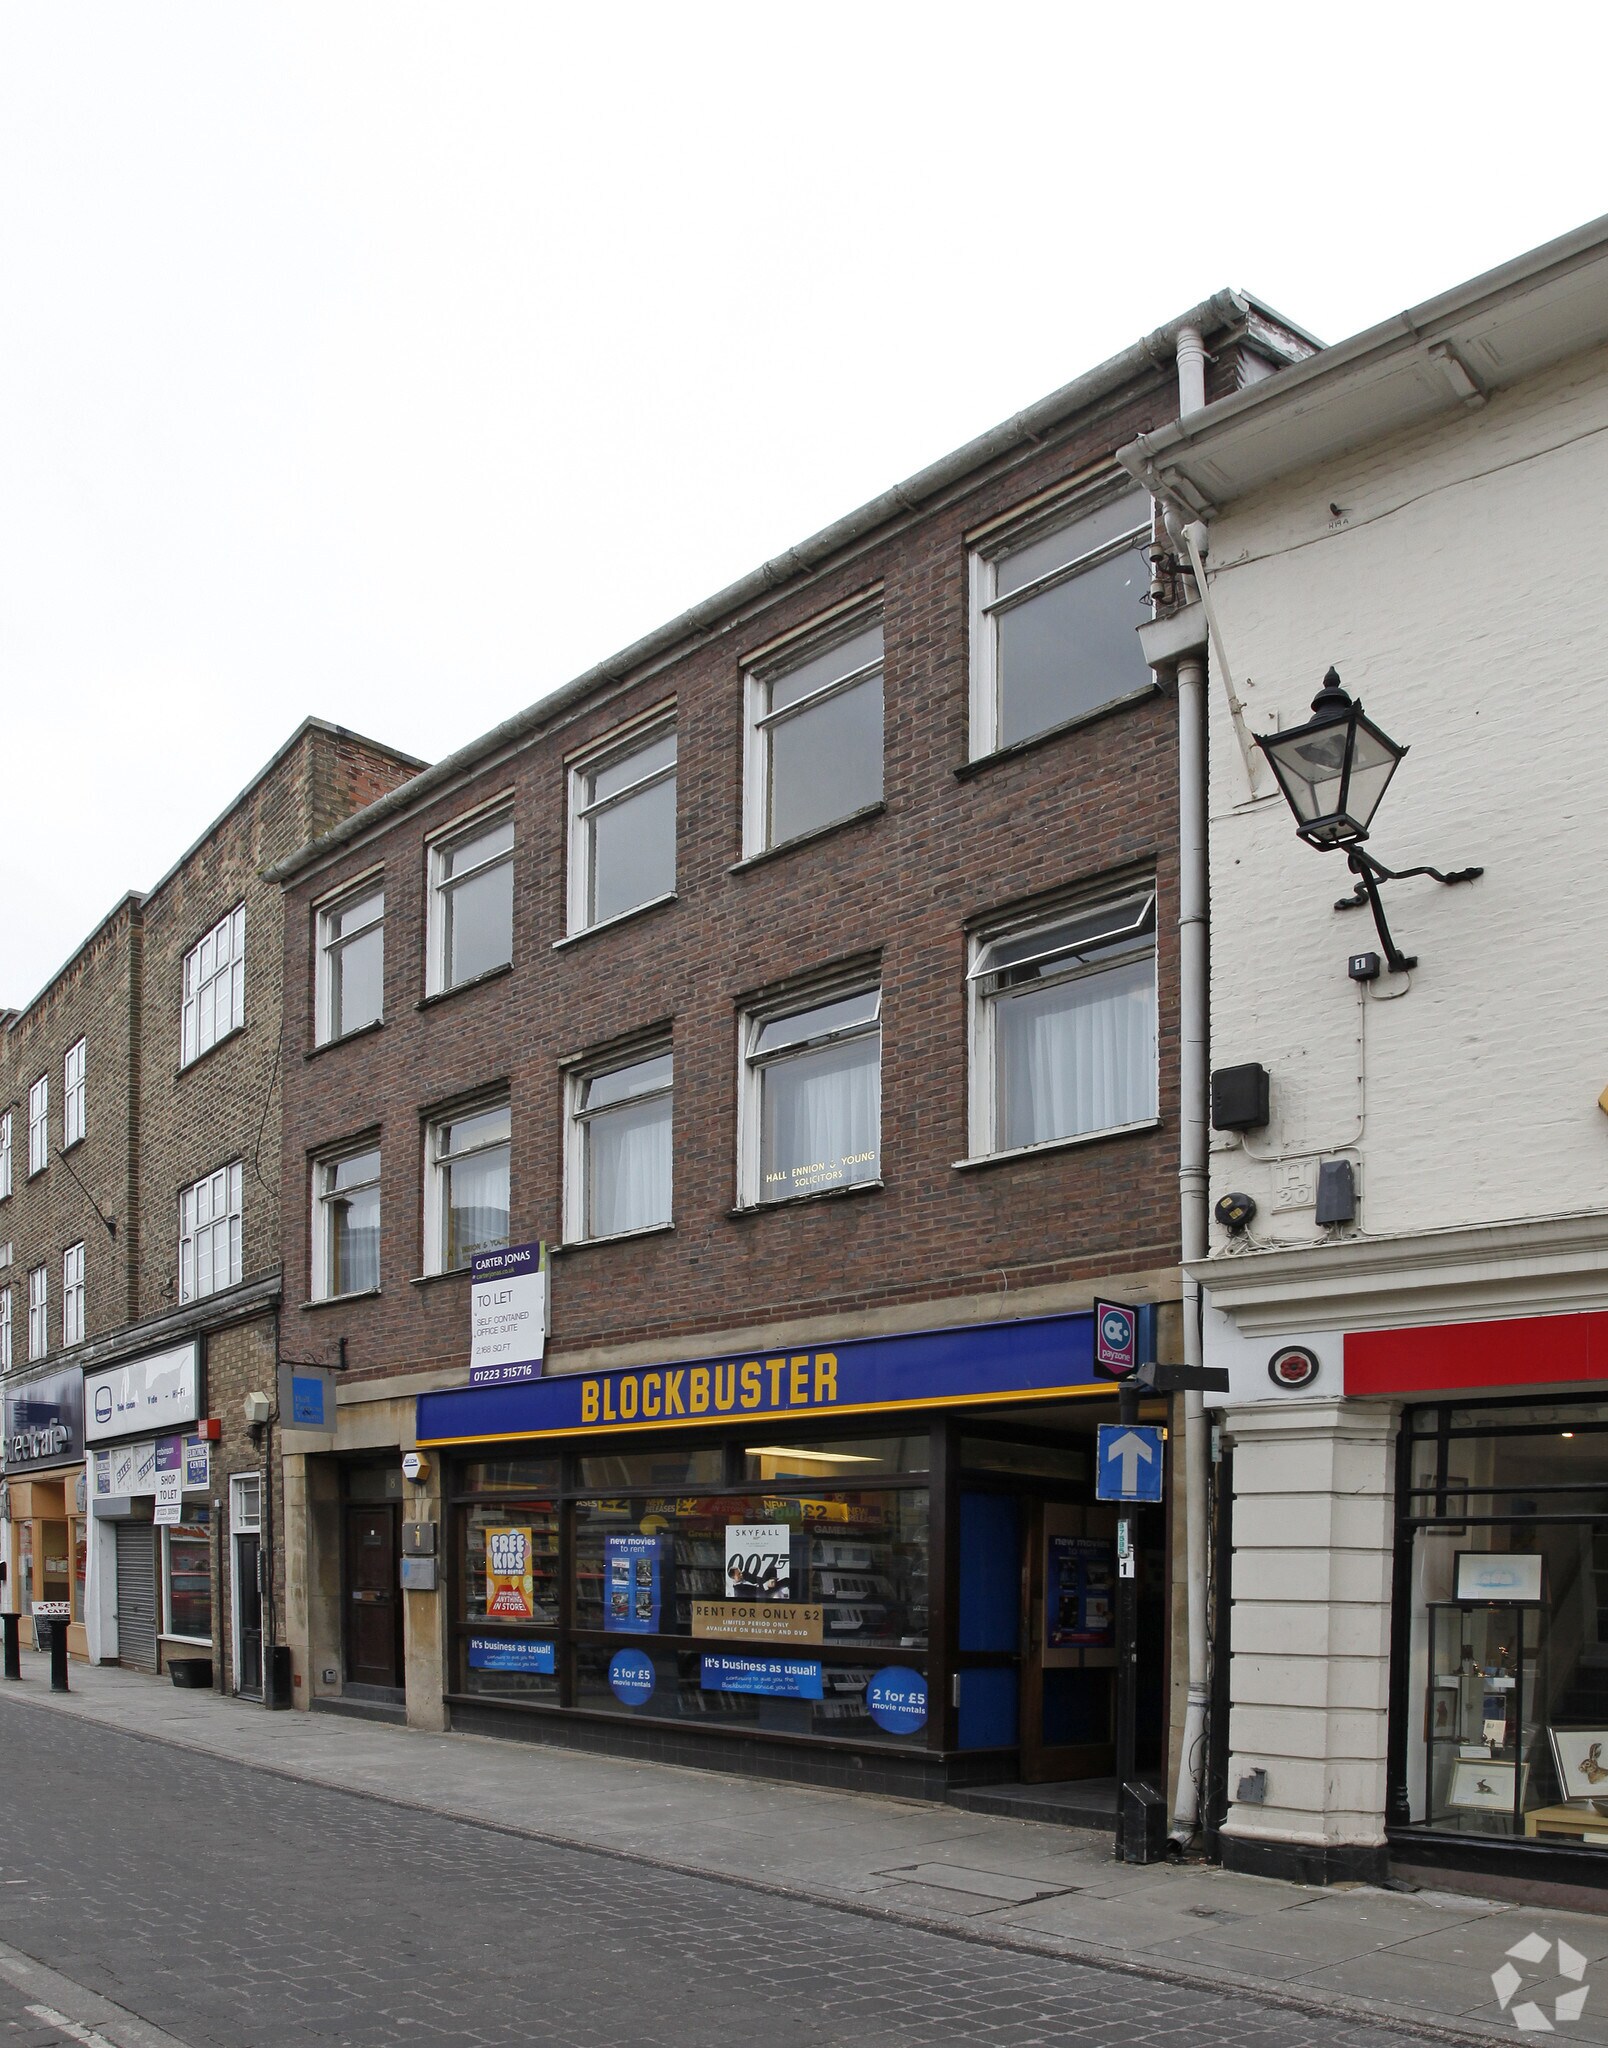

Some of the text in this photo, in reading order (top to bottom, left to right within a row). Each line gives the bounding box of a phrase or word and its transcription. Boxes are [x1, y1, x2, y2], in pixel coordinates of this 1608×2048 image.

[1356, 959, 1362, 969] 1
[766, 1171, 787, 1183] HALL
[792, 1162, 825, 1177] ENNION
[841, 1151, 875, 1166] YOUNG
[794, 1170, 843, 1187] SOLICITORS
[1276, 1160, 1314, 1193] H
[1280, 1190, 1310, 1206] 20
[476, 1256, 503, 1270] CARTER
[504, 1250, 531, 1267] JONAS
[477, 1290, 513, 1307] TO LET
[477, 1311, 530, 1327] SELF CONTAINED
[477, 1323, 518, 1337] OFFICE SUITE
[1102, 1350, 1130, 1361] payzone
[474, 1365, 532, 1382] 01223 315716
[581, 1352, 838, 1423] BLOCKBUSTER
[117, 1461, 132, 1481] SALES
[190, 1460, 206, 1468] CENTRE
[161, 1475, 176, 1485] SHOP
[160, 1490, 177, 1500] TO LET
[764, 1500, 786, 1509] NEW
[803, 1504, 828, 1520] £2
[735, 1529, 780, 1537] SKYFALL
[491, 1534, 525, 1553] FREE
[627, 1537, 656, 1546] movies
[1055, 1538, 1074, 1546] new
[493, 1552, 524, 1569] KIDS
[728, 1553, 784, 1580] 007
[1121, 1562, 1127, 1575] 1
[38, 1602, 70, 1611] STREE
[493, 1603, 501, 1611] IN
[696, 1606, 820, 1620] RENT FOR ONLY £2
[471, 1639, 483, 1649] it's
[484, 1641, 516, 1652] business
[528, 1645, 551, 1654] usual!
[613, 1668, 650, 1680] 2 for £5
[705, 1657, 817, 1676] it's business as usual!
[872, 1689, 925, 1704] 2 for £5
[872, 1703, 926, 1714] movie rentals
